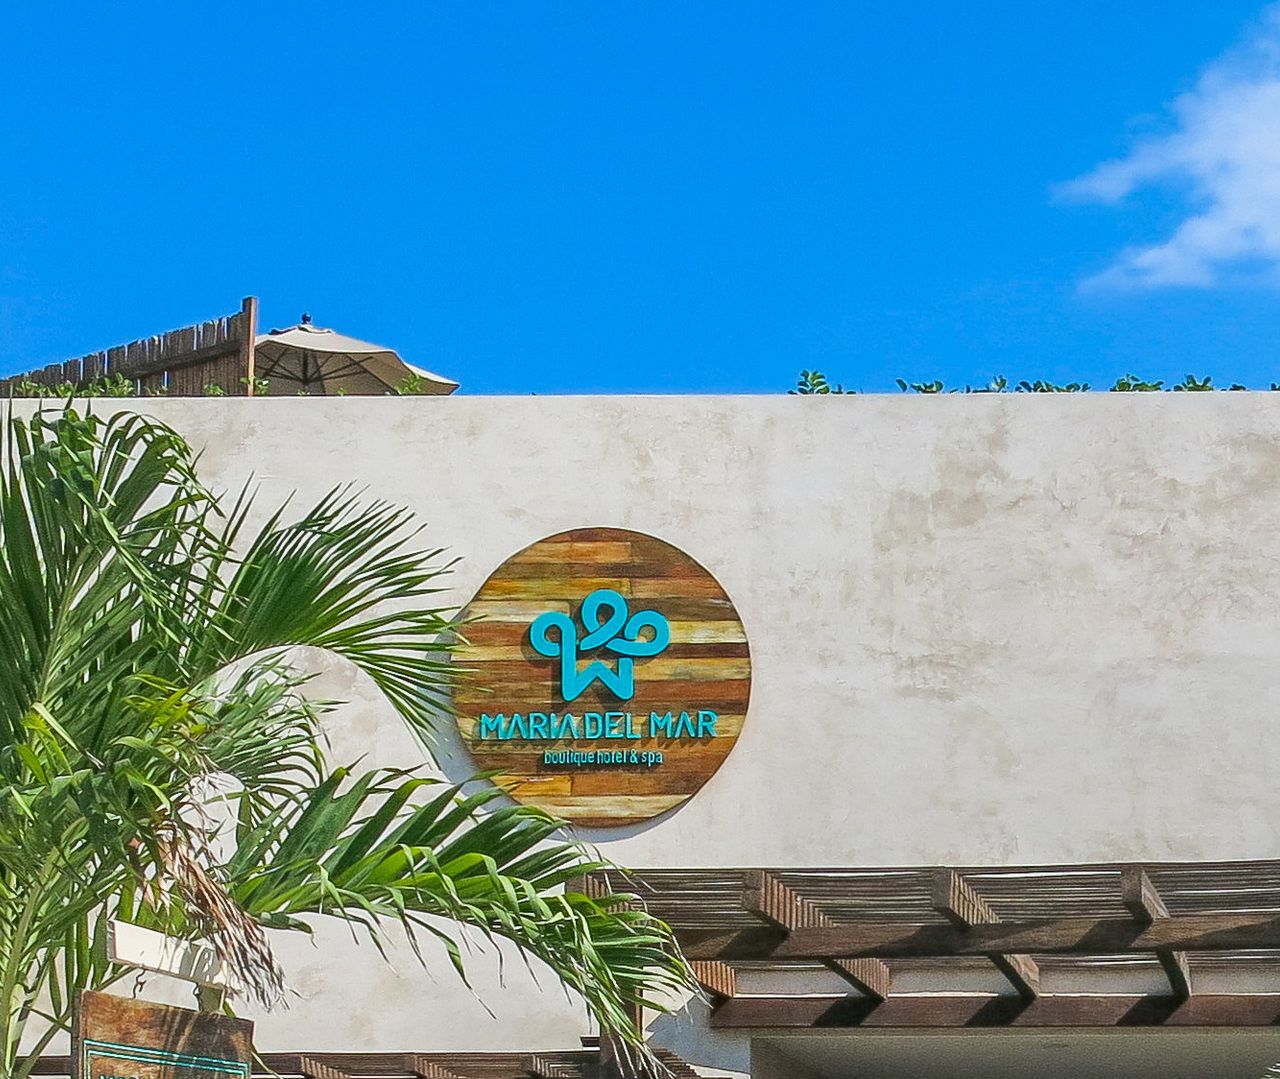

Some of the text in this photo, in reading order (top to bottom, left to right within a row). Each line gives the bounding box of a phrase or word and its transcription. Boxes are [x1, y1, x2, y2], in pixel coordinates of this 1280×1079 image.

[480, 710, 719, 740] MARIA DEL MAR
[544, 749, 664, 767] boutique hotel & spa
